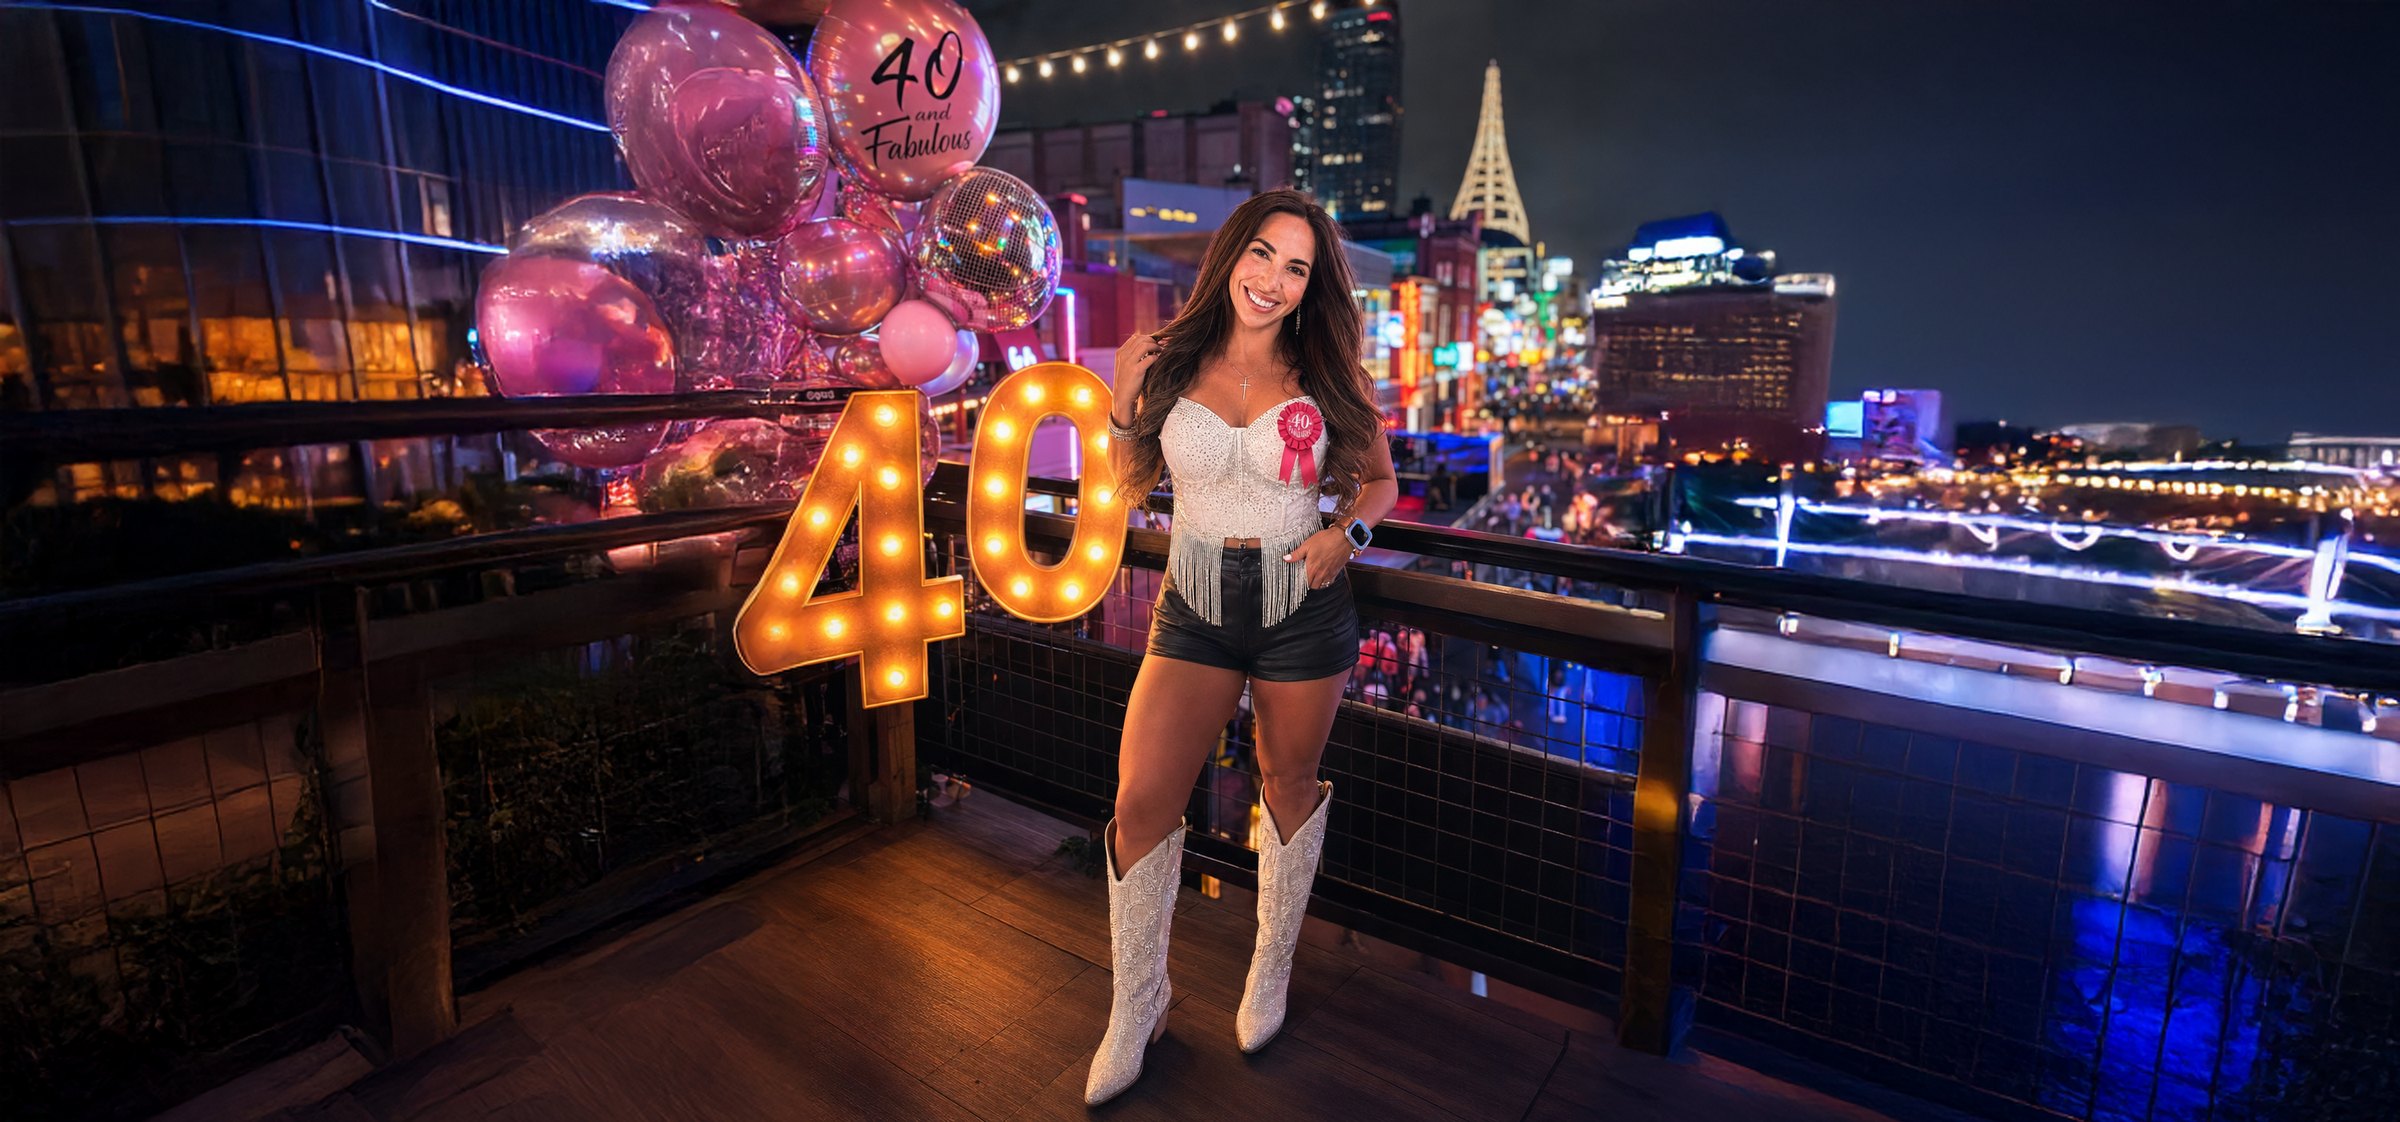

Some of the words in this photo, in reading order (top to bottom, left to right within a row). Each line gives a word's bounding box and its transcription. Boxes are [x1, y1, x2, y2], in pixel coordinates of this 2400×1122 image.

[871, 30, 963, 112] 40
[915, 103, 951, 121] and
[861, 115, 973, 169] Fabulous
[1291, 413, 1310, 430] 40
[733, 362, 1129, 709] 40
